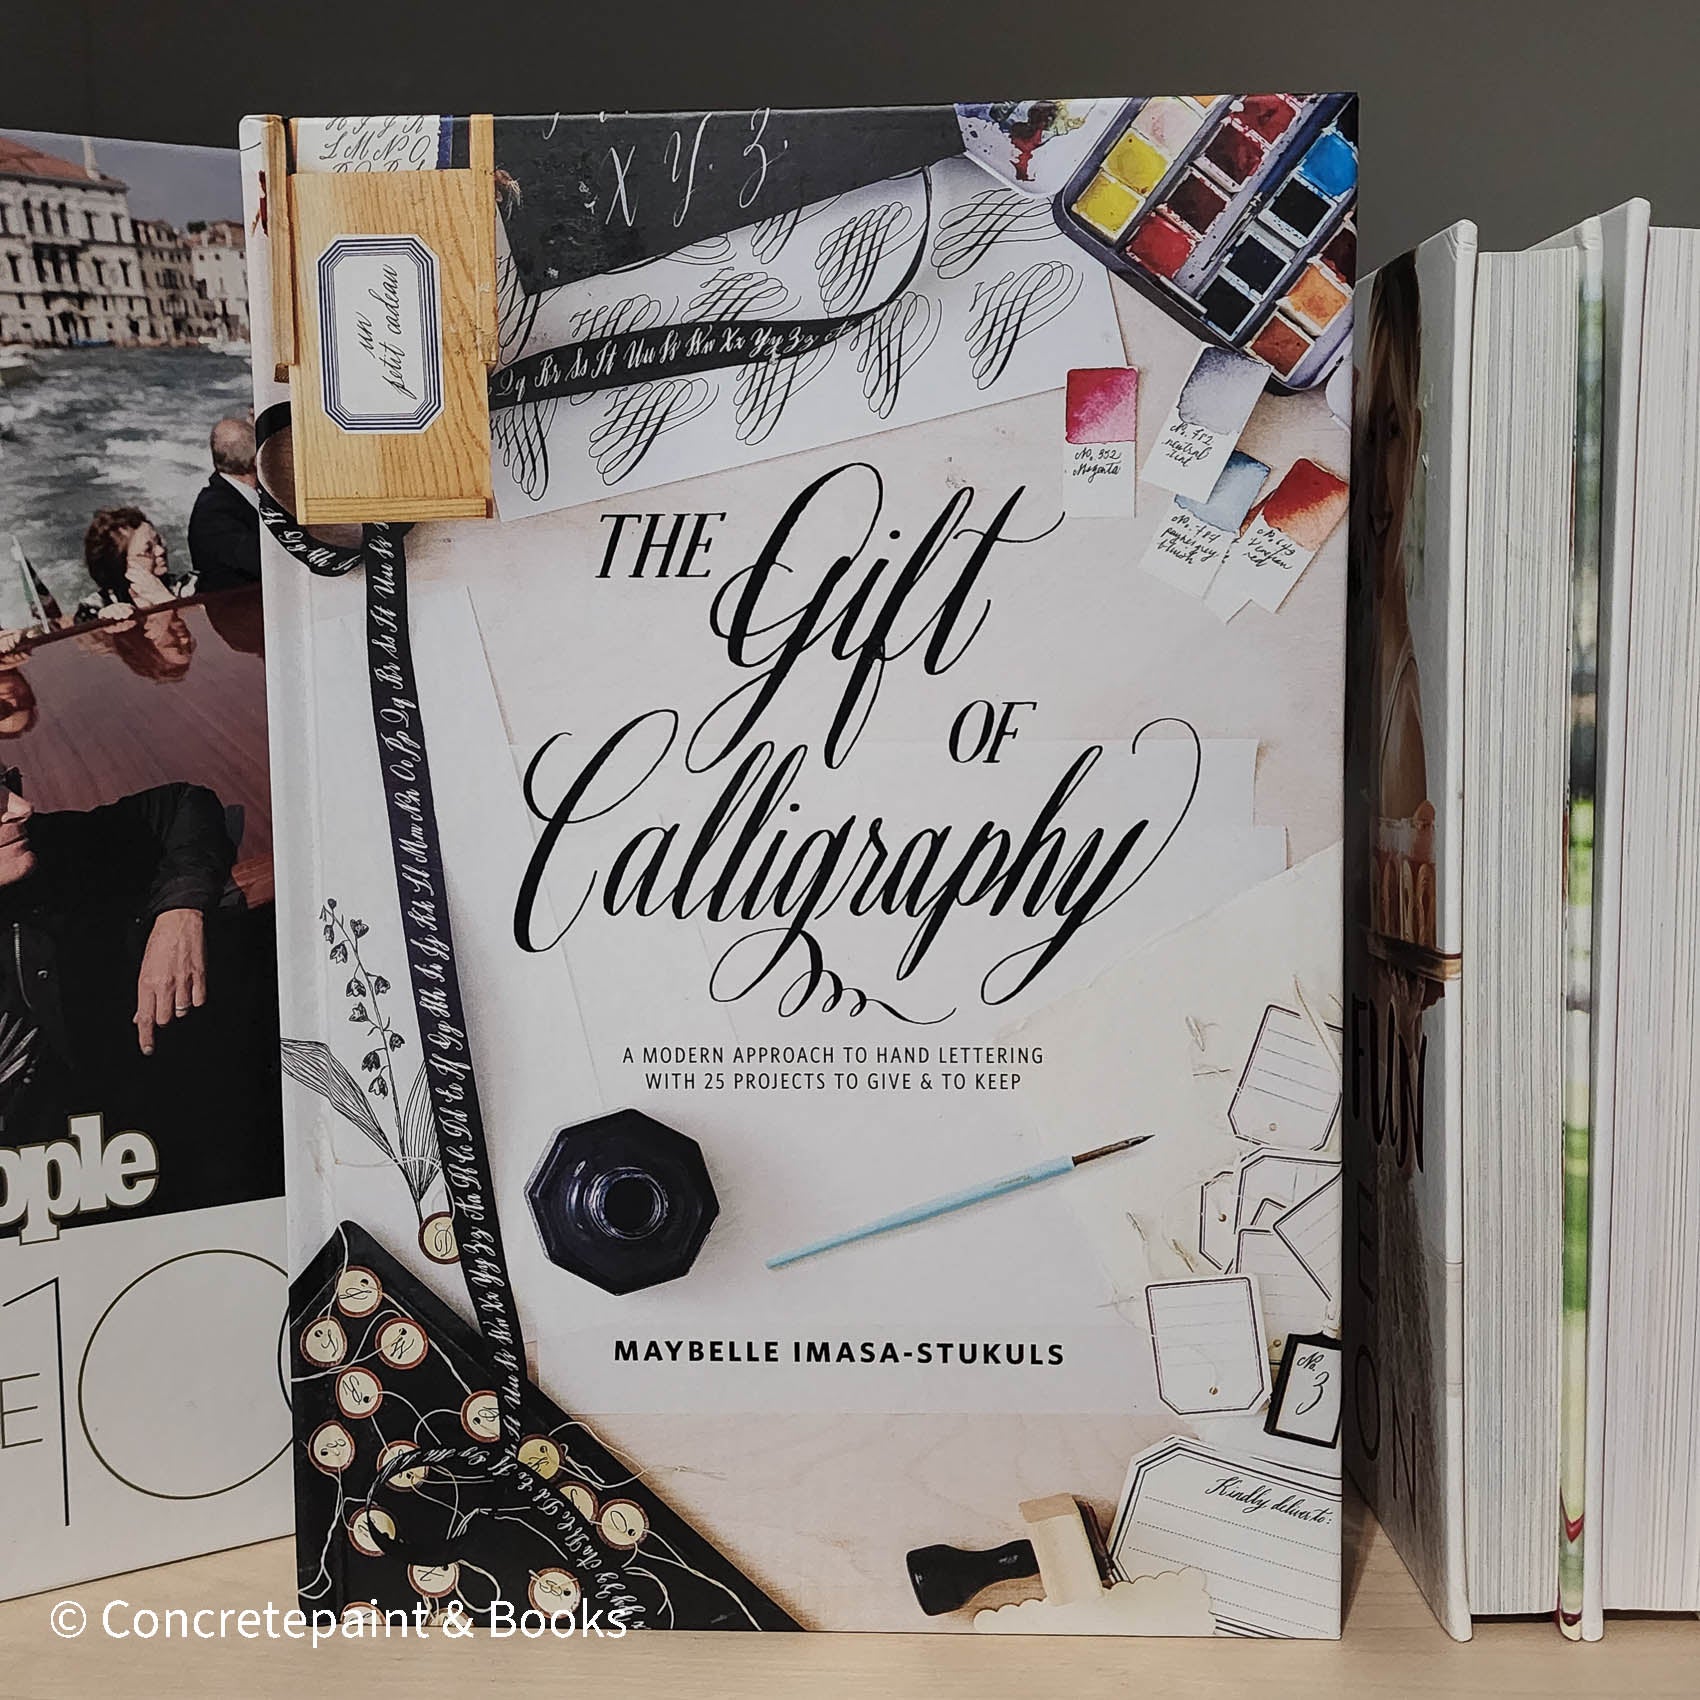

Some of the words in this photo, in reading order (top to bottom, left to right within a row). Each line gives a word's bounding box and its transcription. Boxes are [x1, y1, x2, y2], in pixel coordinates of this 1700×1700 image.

[594, 511, 727, 580] THE
[685, 462, 1066, 774] Gift
[947, 700, 1036, 764] OF
[512, 708, 1202, 1025] Calligraphy
[622, 1046, 635, 1064] A
[642, 1046, 725, 1064] MODERN
[732, 1046, 835, 1064] APPROACH
[843, 1046, 869, 1064] TO
[876, 1046, 930, 1064] HAND
[938, 1046, 1045, 1065] LETTERING
[644, 1072, 696, 1090] WITH
[703, 1072, 726, 1090] 25
[733, 1072, 826, 1091] PROJECTS
[834, 1072, 859, 1090] TO
[866, 1072, 912, 1090] GIVE
[919, 1072, 934, 1090] &
[942, 1072, 966, 1090] TO
[975, 1072, 1023, 1091] KEEP
[613, 1339, 780, 1363] MAYBELLE
[792, 1340, 1066, 1366] IMASA-STUKULS
[1294, 1371, 1331, 1416] 3
[1204, 1475, 1273, 1514] Kindly
